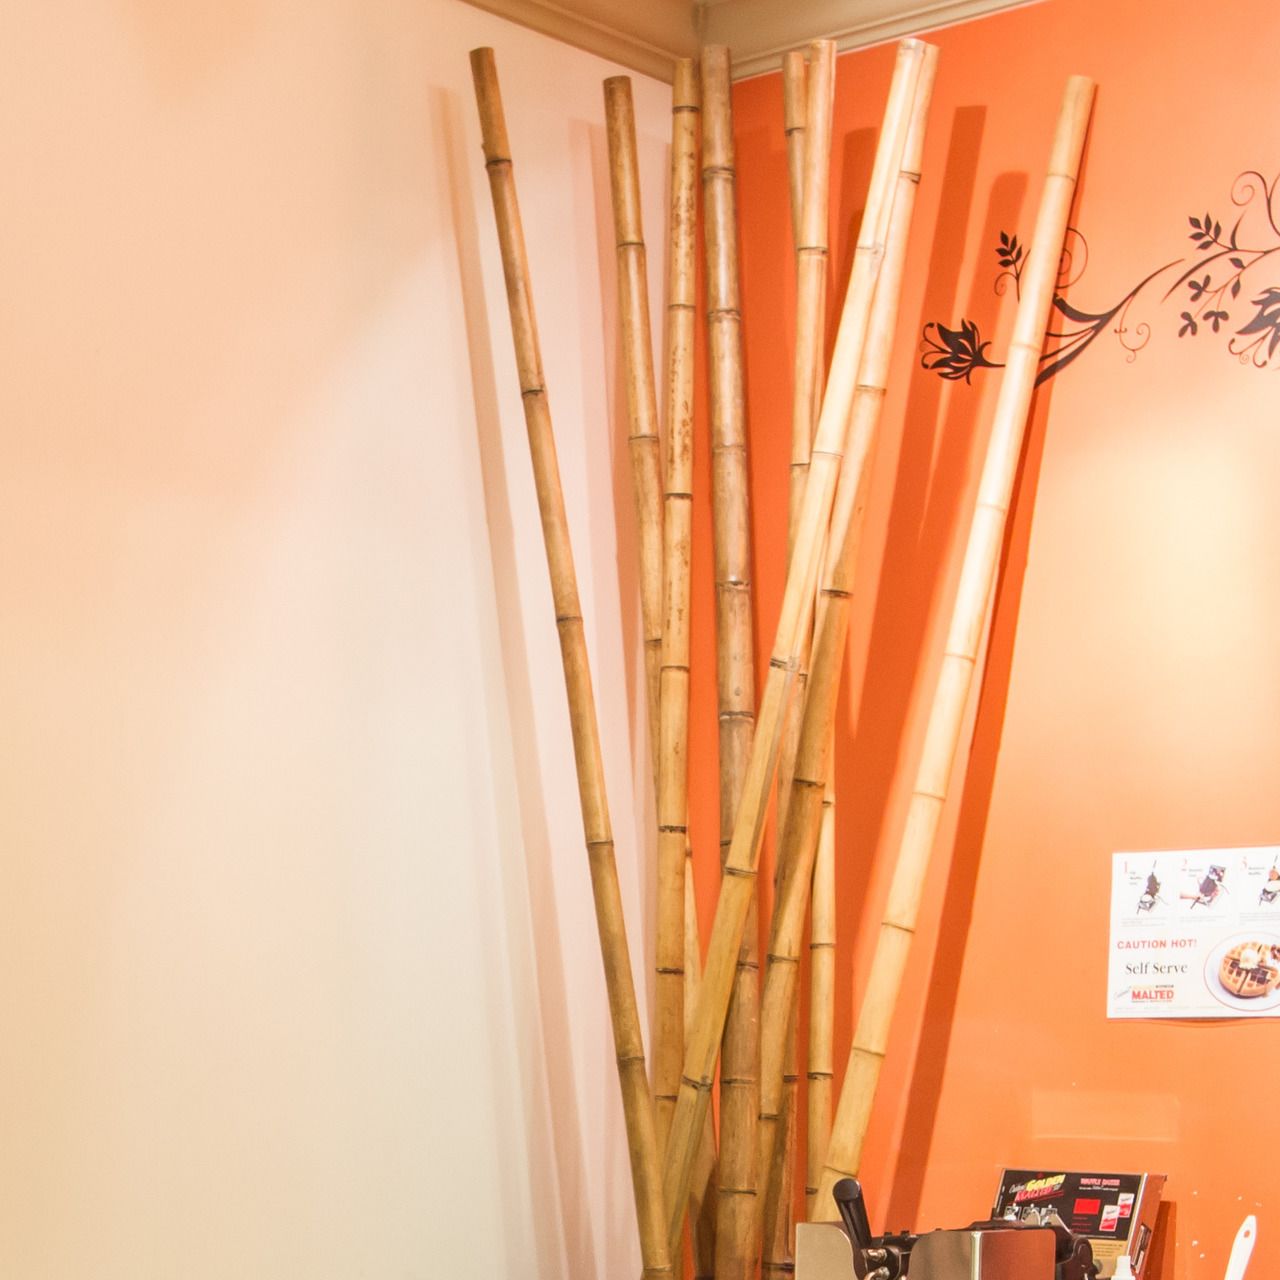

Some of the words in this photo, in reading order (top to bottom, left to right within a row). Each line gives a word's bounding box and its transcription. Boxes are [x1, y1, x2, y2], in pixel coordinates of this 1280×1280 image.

[1117, 940, 1166, 949] CAUTION
[1125, 961, 1149, 974] Self
[1153, 962, 1188, 974] Serve
[1132, 990, 1174, 1000] MALTED
